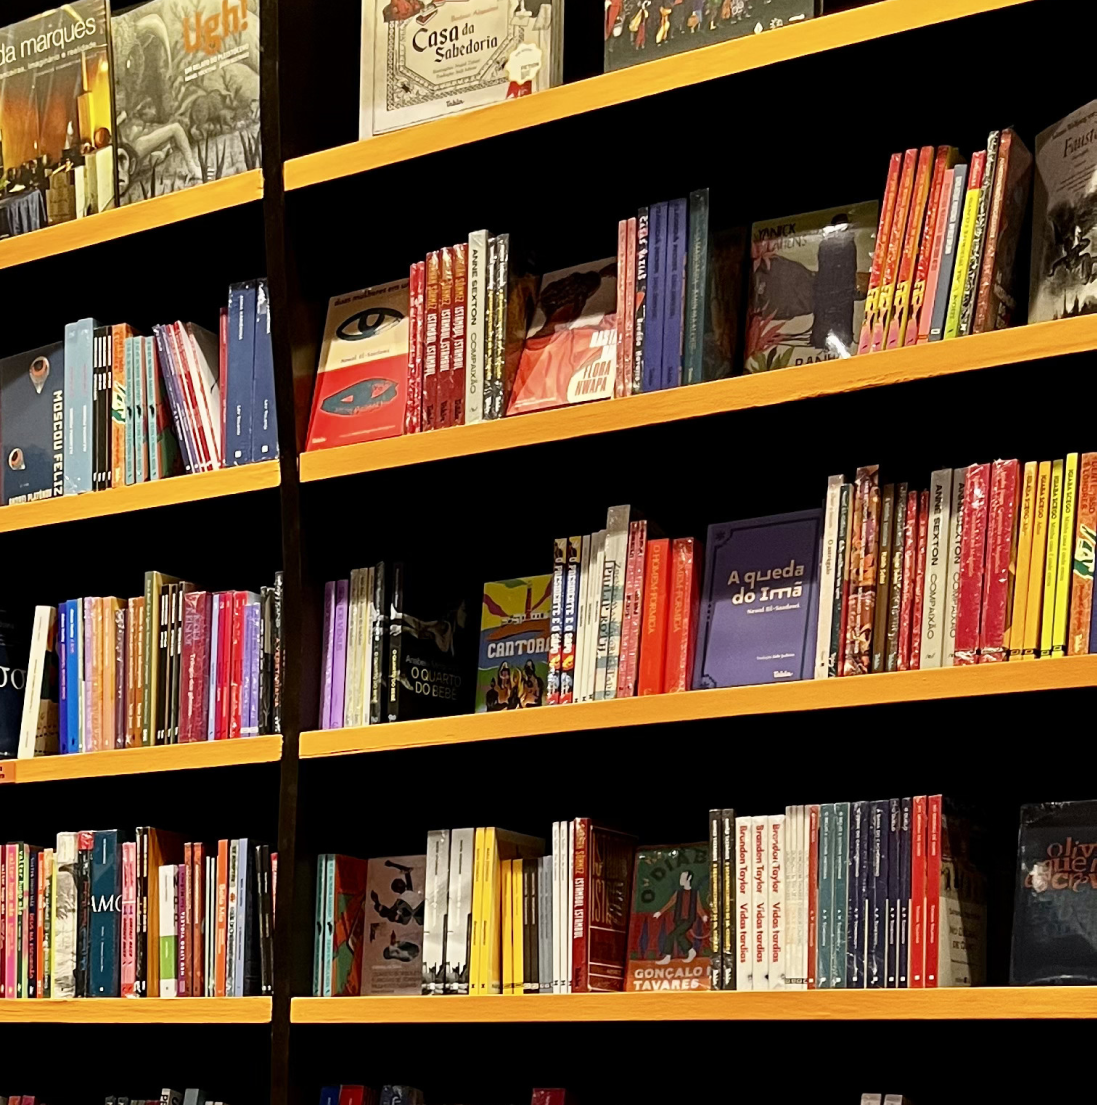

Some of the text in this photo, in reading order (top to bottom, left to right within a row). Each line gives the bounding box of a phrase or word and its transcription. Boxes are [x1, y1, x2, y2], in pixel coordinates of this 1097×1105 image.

[20, 17, 97, 58] marques
[182, 0, 249, 55] Ugh!
[412, 23, 475, 52] Casa da
[434, 36, 498, 63] Sabedoria
[583, 359, 612, 380] FLORA
[575, 377, 606, 396] NWAPA
[53, 390, 64, 496] MOSCOU FELIZ
[728, 560, 805, 590] A queda
[926, 484, 943, 640] ANNE SEXTON COMPAIXÃO
[731, 587, 756, 606] do
[411, 666, 461, 685] O QUARTO
[415, 681, 430, 694] DO
[738, 824, 748, 963] Brandon Taylor Vidas tardias
[755, 824, 765, 963] Brandon Taylor Vidas tardias
[771, 864, 781, 963] Taylor Vidas tardias
[632, 979, 700, 992] TAVARES
[634, 967, 700, 982] GONÇALO
